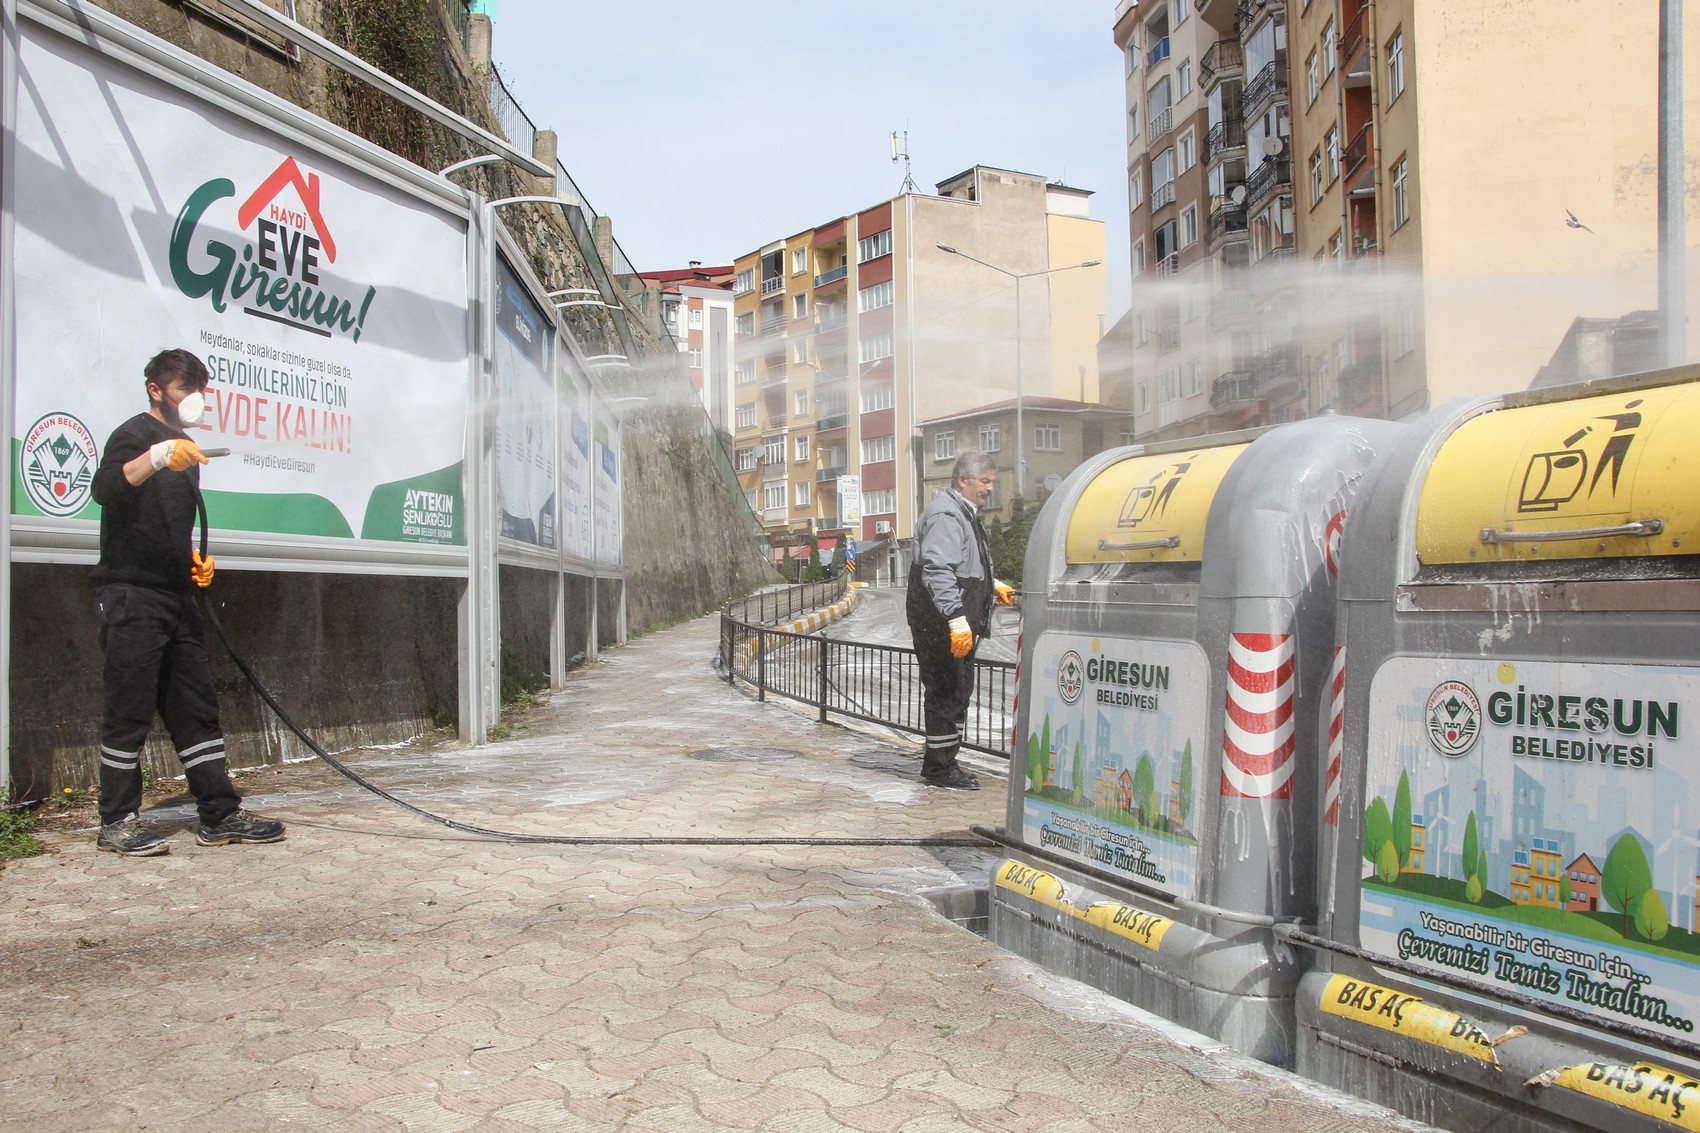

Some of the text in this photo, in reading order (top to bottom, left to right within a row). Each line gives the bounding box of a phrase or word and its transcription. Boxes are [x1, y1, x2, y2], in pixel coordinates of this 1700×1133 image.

[270, 204, 307, 231] HAYDİ
[169, 178, 376, 344] Giresun!
[258, 217, 320, 285] EVE
[200, 329, 353, 381] Meydanlar, sokaklar sizinle güzel olsa da,
[207, 355, 347, 411] SEVDİKLERİNİZ İÇİN
[26, 417, 97, 458] GİRESUN BELEDİYESİ
[200, 387, 352, 455] EVDE KALIN!
[54, 446, 70, 456] 1869
[243, 453, 316, 474] #HaydiEveGiresun
[403, 488, 454, 514] AYTEKİN
[1086, 654, 1170, 690] GİRESUN
[1096, 688, 1159, 711] BELEDİYESİ
[1449, 684, 1479, 712] BELEDİYESİ
[1487, 685, 1679, 739] GİRESUN
[1512, 735, 1654, 769] BELEDİYESİ
[1051, 811, 1090, 834] Yaşanabilir
[1090, 822, 1101, 837] bir
[1100, 826, 1129, 846] Giresun
[1005, 864, 1027, 885] BAS
[1112, 906, 1162, 944] BAS AÇ
[1420, 911, 1652, 985] Yaşanabilir bir Giresun için...
[1397, 928, 1694, 1033] Çevremizi Temiz Tutalım...
[1337, 981, 1414, 1028] BAS AÇ
[1449, 1017, 1491, 1047] BA
[1648, 1073, 1699, 1119] AÇ
